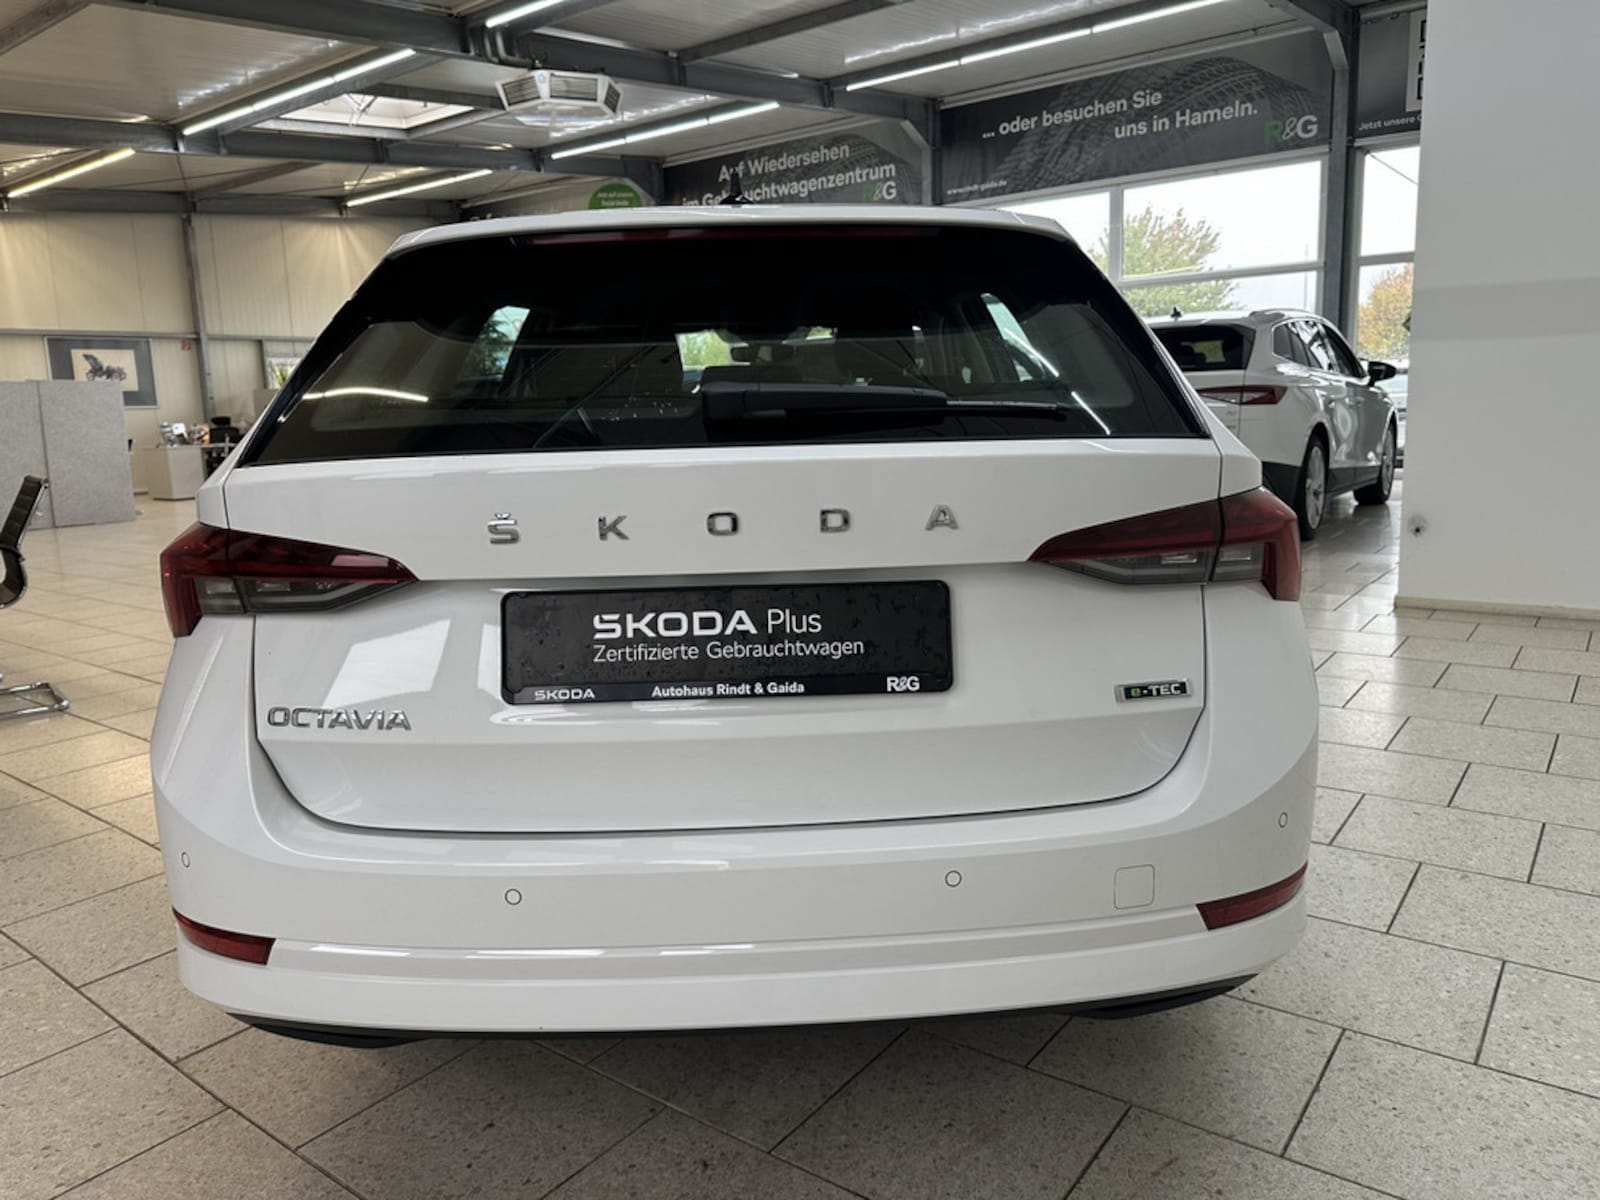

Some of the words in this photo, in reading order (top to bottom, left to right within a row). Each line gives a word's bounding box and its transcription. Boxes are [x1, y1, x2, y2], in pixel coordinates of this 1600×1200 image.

[998, 114, 1038, 137] oder
[1041, 95, 1128, 128] besuchen
[1132, 89, 1163, 110] Sie
[1113, 121, 1149, 140] uns
[1152, 114, 1171, 134] in
[1174, 99, 1260, 130] Hameln.
[1263, 114, 1319, 144] R&G
[747, 142, 850, 176] Wiedersehen
[767, 607, 822, 634] Plus
[593, 642, 700, 662] Zertifizierte
[706, 639, 865, 661] Gebrauchtwagen
[651, 684, 714, 698] Autohaus
[716, 682, 751, 696] Rindt
[753, 682, 765, 695] &
[766, 681, 805, 695] Gaida
[886, 675, 920, 693] R&G
[1130, 683, 1182, 697] e-TEC
[267, 706, 412, 731] OCTAVIA
